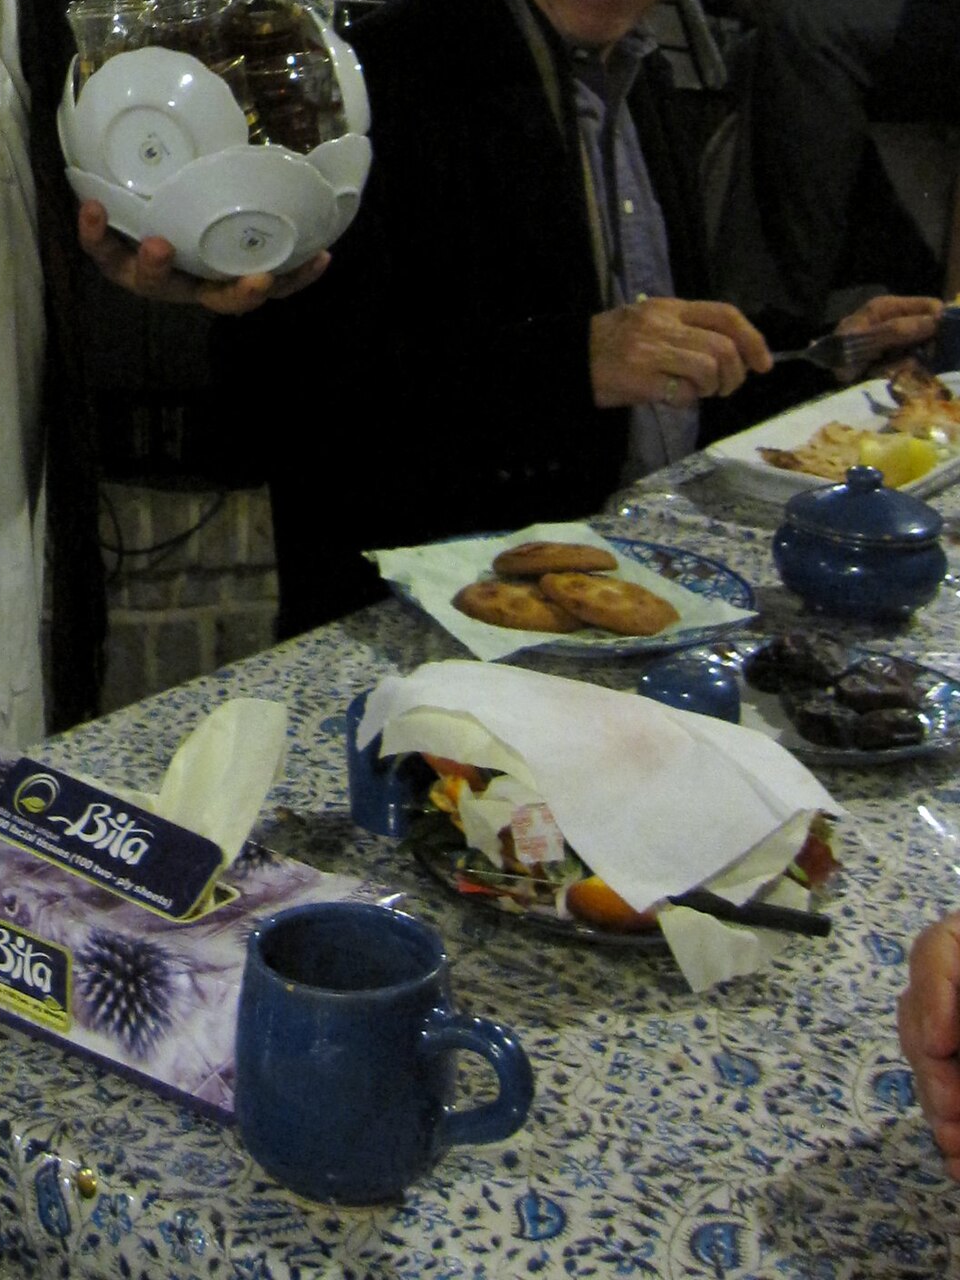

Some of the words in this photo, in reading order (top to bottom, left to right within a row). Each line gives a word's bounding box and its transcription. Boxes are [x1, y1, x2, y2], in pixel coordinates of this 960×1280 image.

[9, 824, 37, 842] facial
[36, 838, 70, 859] tissues
[47, 803, 154, 865] Bita
